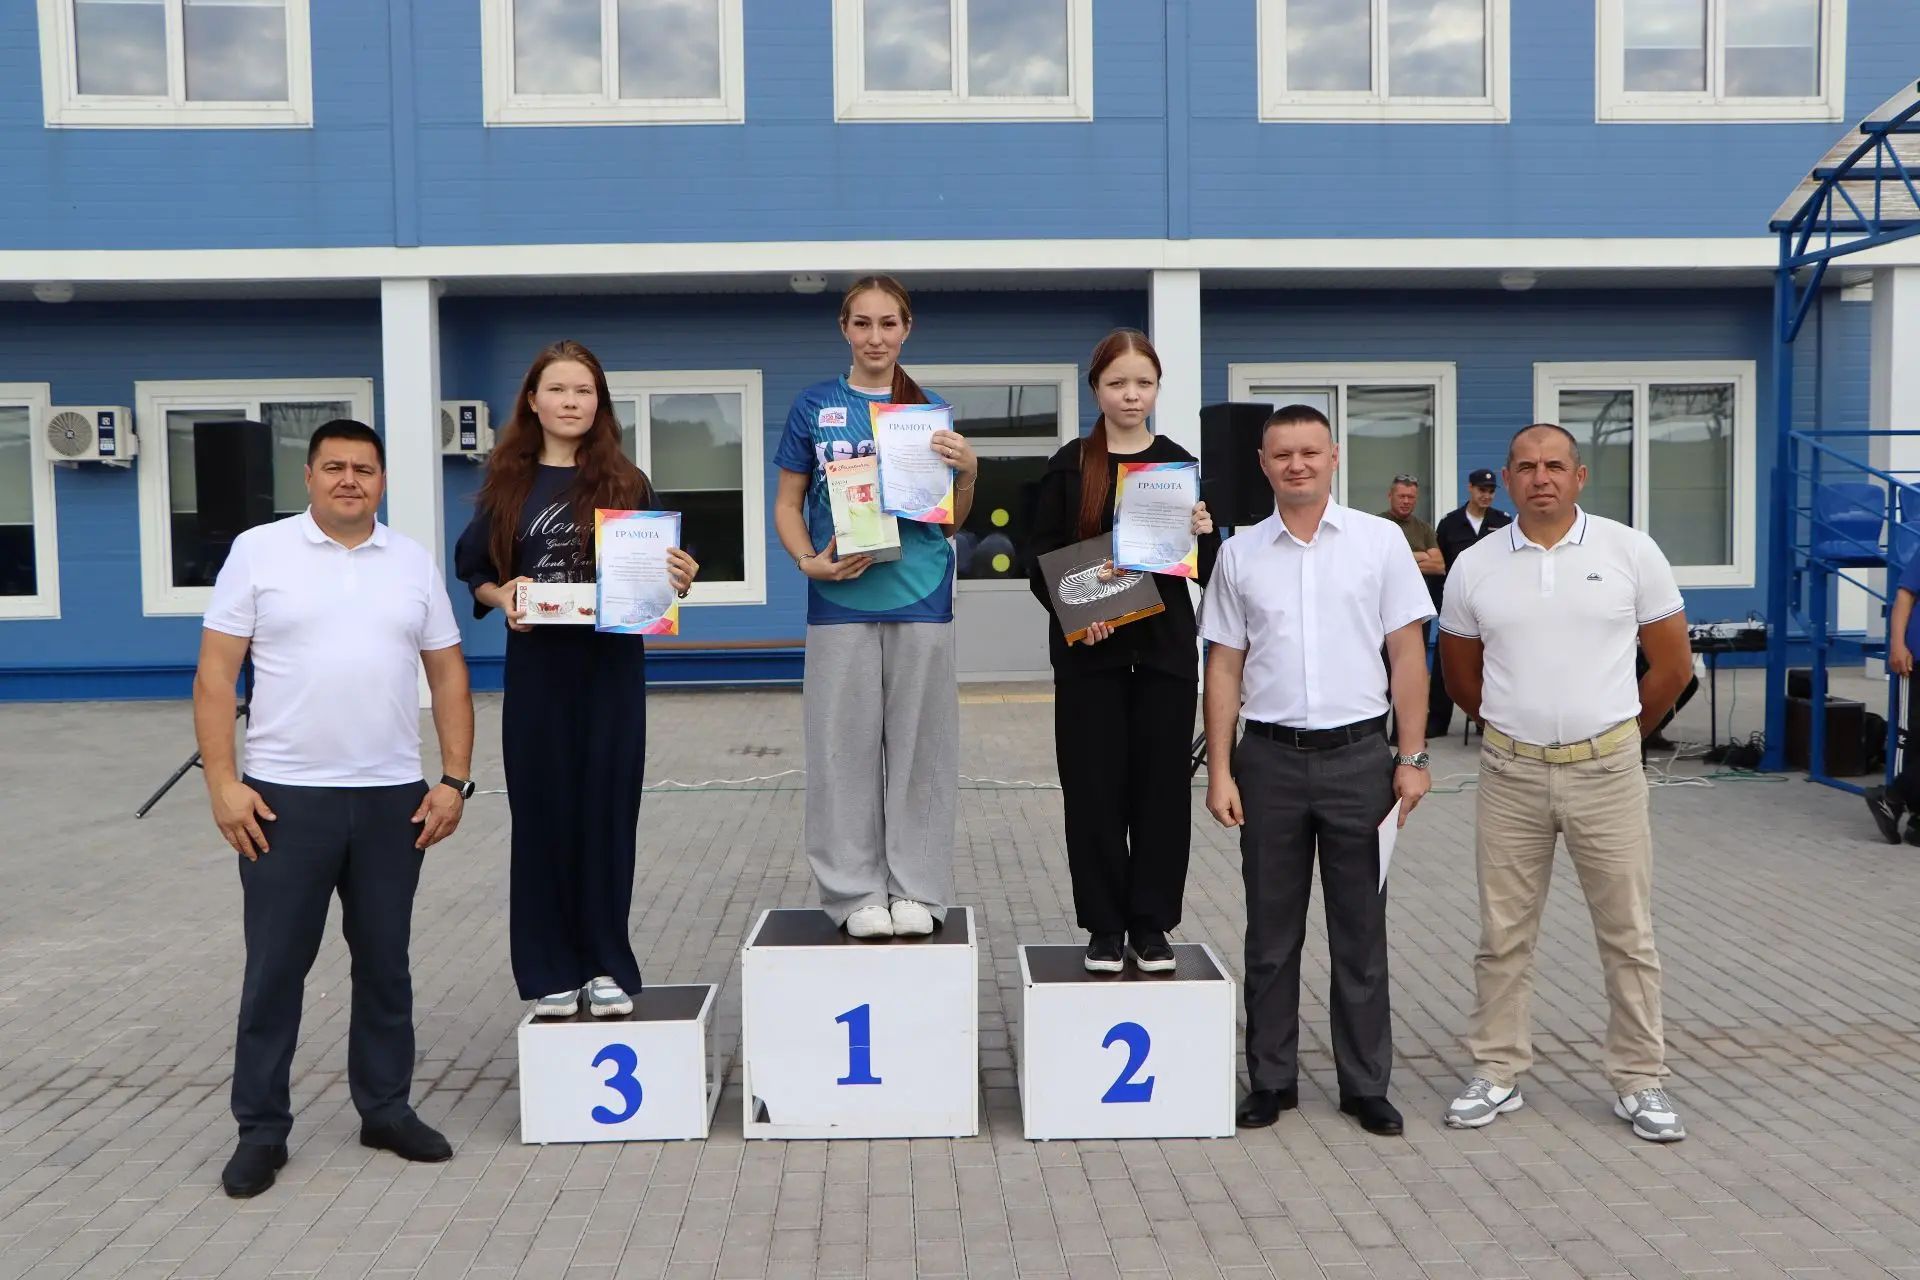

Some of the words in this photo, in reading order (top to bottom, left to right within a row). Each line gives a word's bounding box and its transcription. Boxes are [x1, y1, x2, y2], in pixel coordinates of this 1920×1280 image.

[889, 423, 932, 432] ГРАМОТА
[1138, 482, 1182, 490] ГРАМОТА
[615, 530, 660, 539] ГРАМОТА
[838, 1004, 880, 1084] 1
[1104, 1022, 1154, 1102] 2
[592, 1043, 642, 1124] 3
